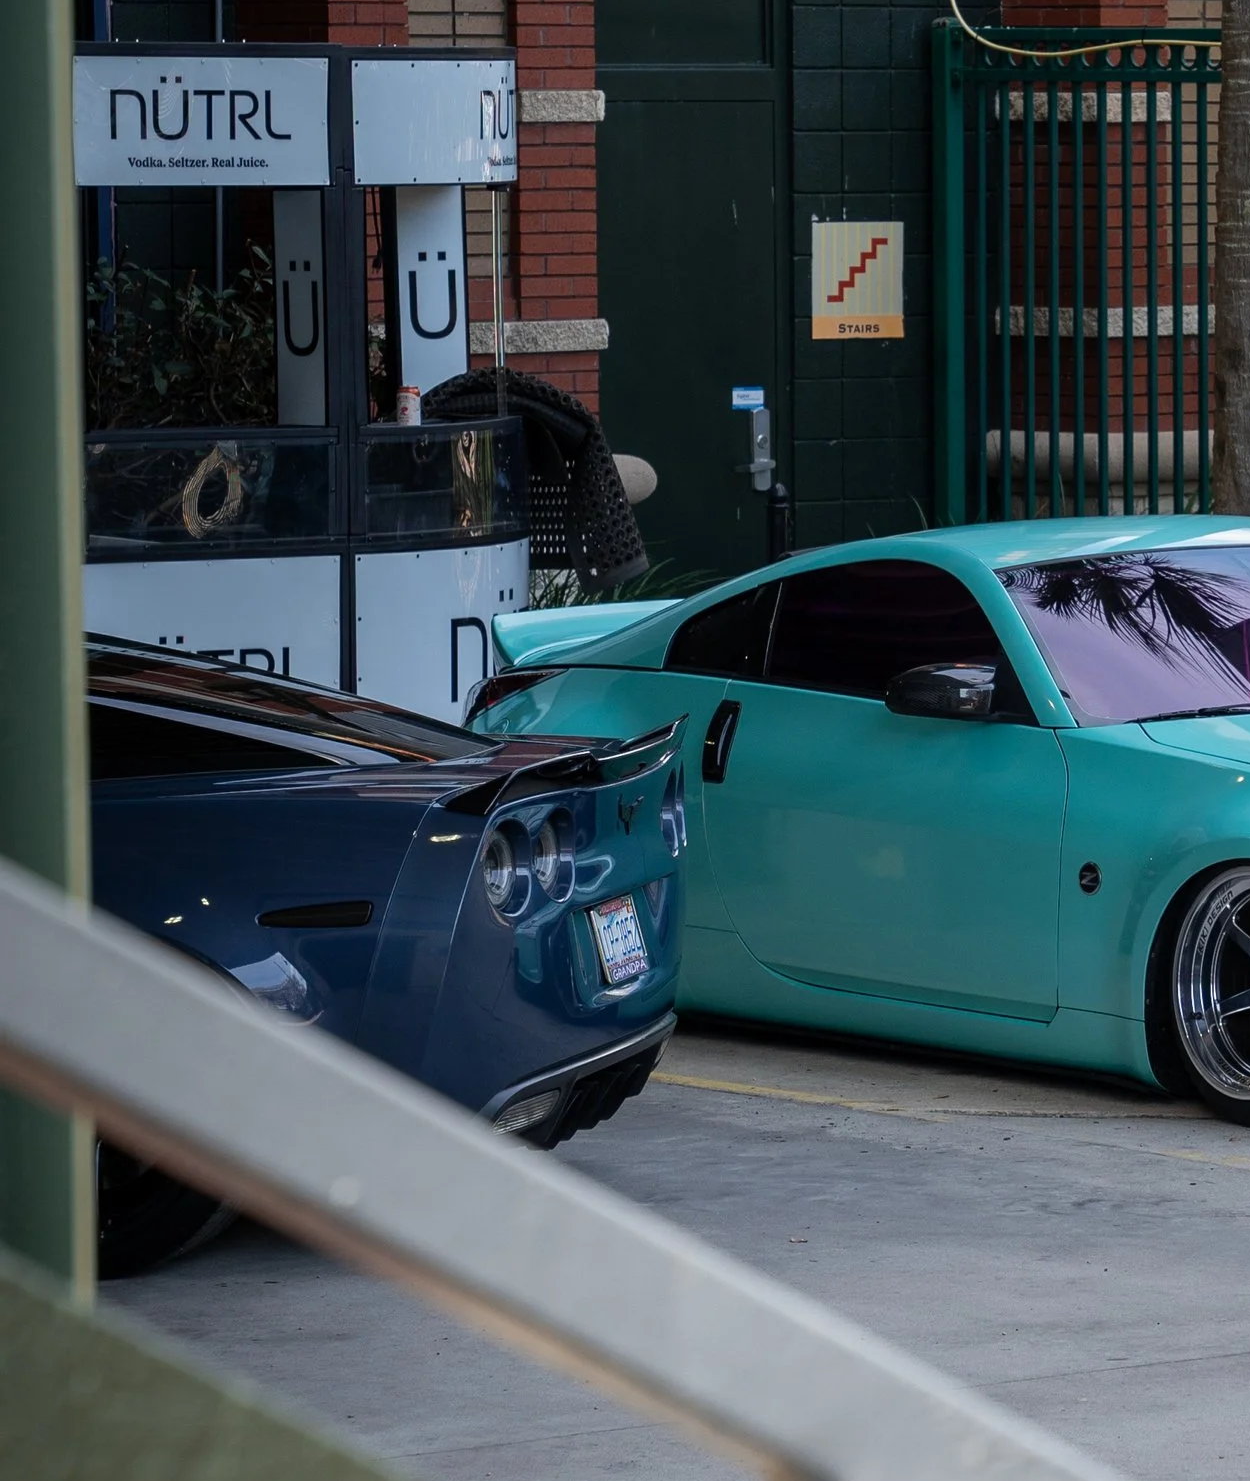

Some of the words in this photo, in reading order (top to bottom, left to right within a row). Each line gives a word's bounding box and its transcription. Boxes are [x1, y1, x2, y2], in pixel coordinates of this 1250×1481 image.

[127, 157, 166, 168] Vodka.
[168, 157, 209, 168] Seltzer.
[211, 157, 235, 168] Real
[236, 157, 269, 168] Juice.
[838, 323, 880, 334] STAIRS
[612, 959, 647, 980] GRANDPA
